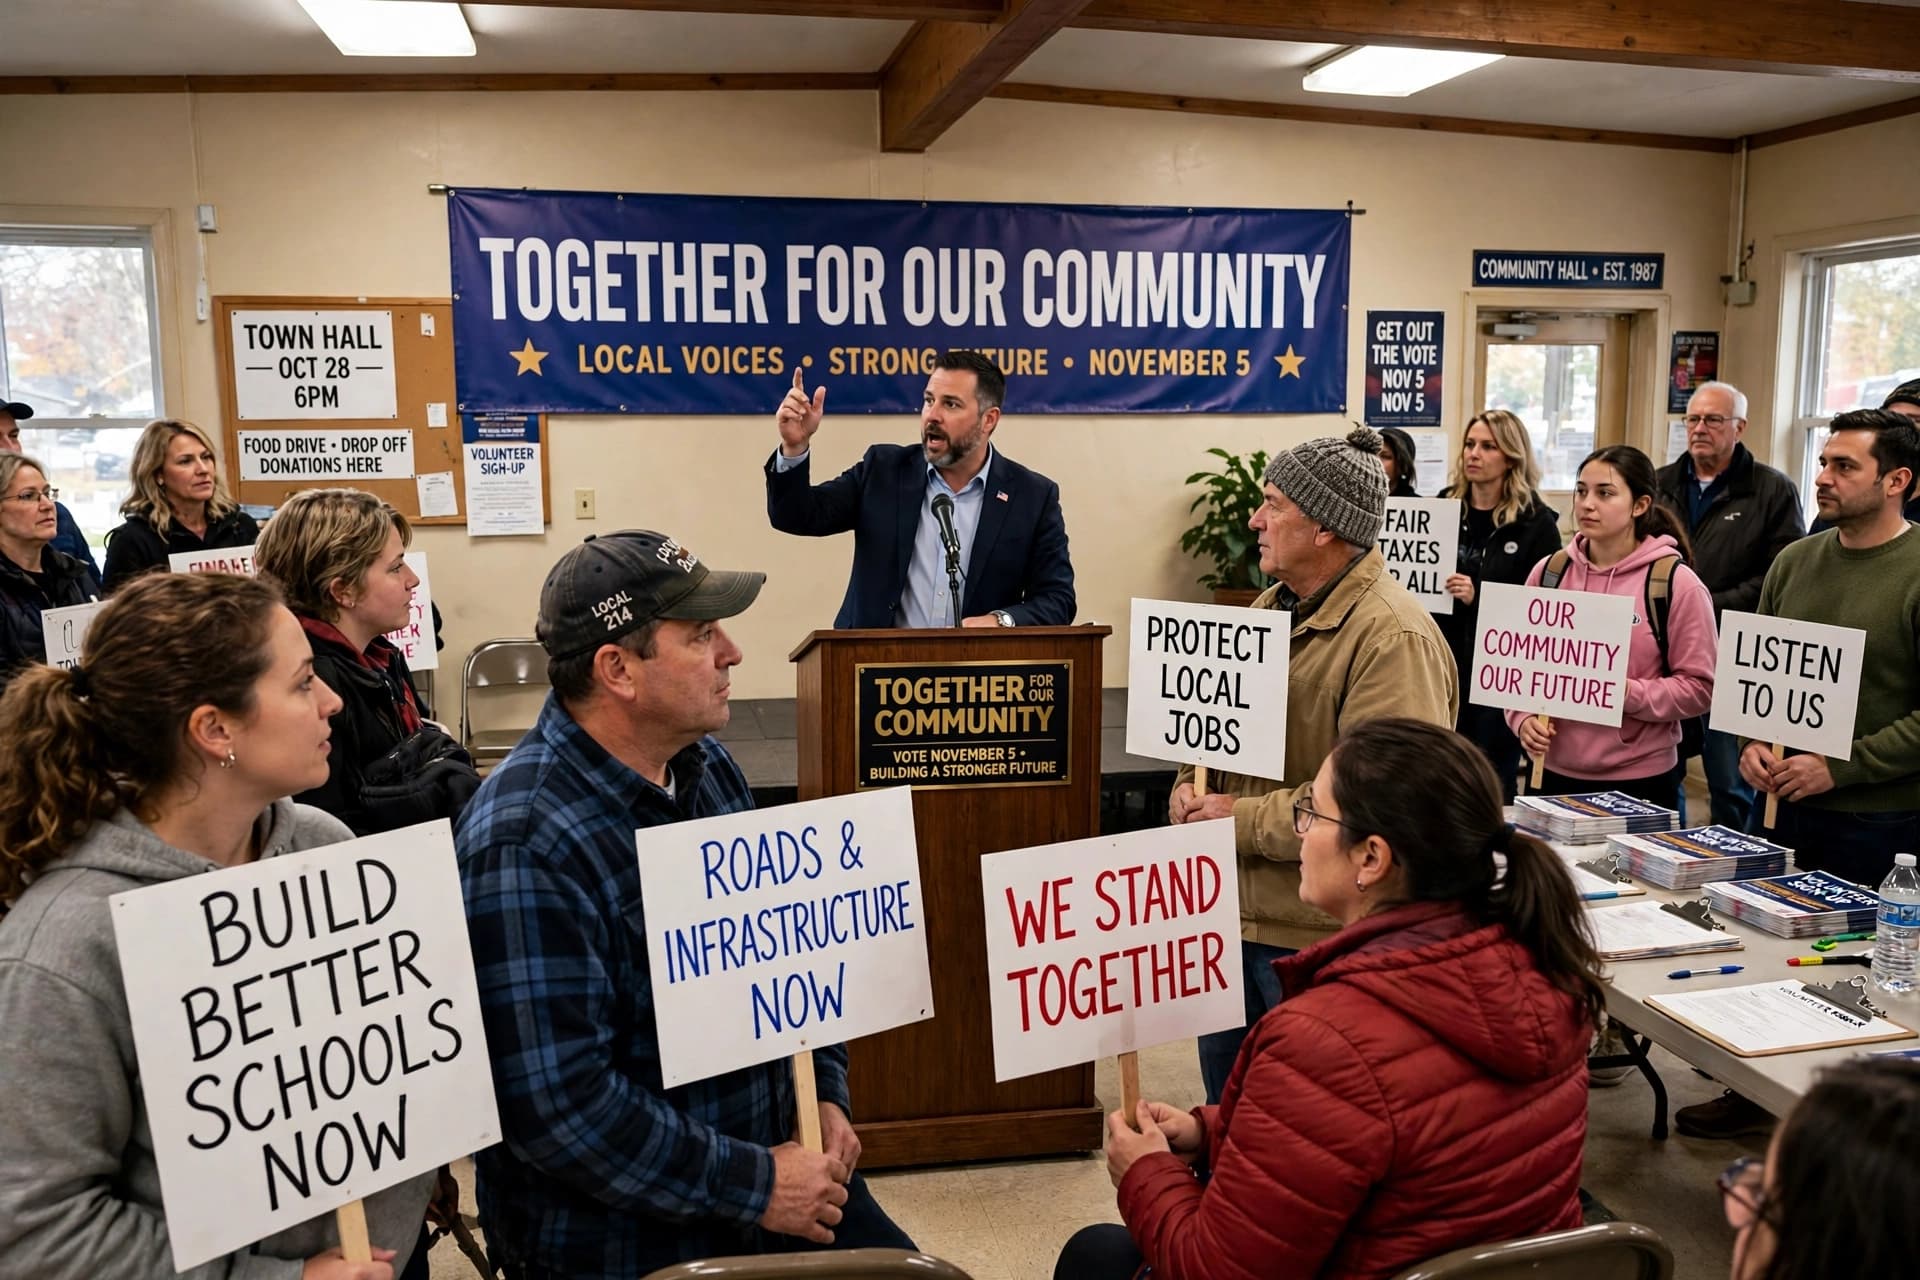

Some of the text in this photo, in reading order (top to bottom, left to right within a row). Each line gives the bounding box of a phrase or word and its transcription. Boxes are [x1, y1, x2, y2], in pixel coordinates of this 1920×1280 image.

[479, 237, 1326, 329] TOGETHER FOR OUR COMMUNITY
[1479, 258, 1657, 281] COMMUNITY HALL EST. 1987
[243, 324, 382, 349] TOWN HALL
[1376, 321, 1435, 341] GET OUT
[278, 356, 350, 379] OCT 28
[578, 344, 1250, 377] LOCAL VOICES STRONG TURE NOVEMBER 5
[1372, 344, 1437, 365] THE VOTE
[1382, 369, 1425, 389] NOV 5
[294, 385, 339, 408] 6PM
[1381, 392, 1425, 412] NOV 5
[244, 437, 407, 454] FOOD DRIVE DROP OFF
[471, 448, 534, 460] VOLUNTEER
[260, 457, 383, 474] DONATIONS HERE
[1385, 509, 1430, 534] FAIR
[1378, 538, 1440, 564] TAXES
[1406, 570, 1443, 595] ALL
[591, 590, 632, 618] LOCAL
[603, 606, 633, 631] 214
[1528, 598, 1575, 630] OUR
[1147, 615, 1271, 663] PROTECT
[1484, 629, 1620, 671] COMMUNITY
[1734, 630, 1843, 684] LISTEN
[874, 675, 1025, 705] TOGETHER
[1028, 688, 1054, 703] OUR
[1029, 674, 1054, 687] FOR
[1161, 663, 1250, 709] LOCAL
[1479, 664, 1616, 709] OUR FUTURE
[1737, 678, 1825, 728] TO US
[874, 705, 1055, 737] COMMUNITY
[1165, 709, 1241, 755] JOBS
[870, 761, 1057, 780] BUILDING A STRONGER FUTURE
[893, 747, 1016, 764] VOTE NOVEMBER 5
[700, 820, 864, 899] ROADS &
[200, 858, 397, 967] BUILD
[1005, 855, 1221, 948] WE STAND
[664, 880, 915, 984] INFRASTRUCTURE
[181, 929, 432, 1062] BETTER
[1007, 931, 1228, 1032] TOGETHER
[751, 961, 845, 1039] NOW
[185, 998, 463, 1150] SCHOOLS
[262, 1094, 407, 1211] NOW
